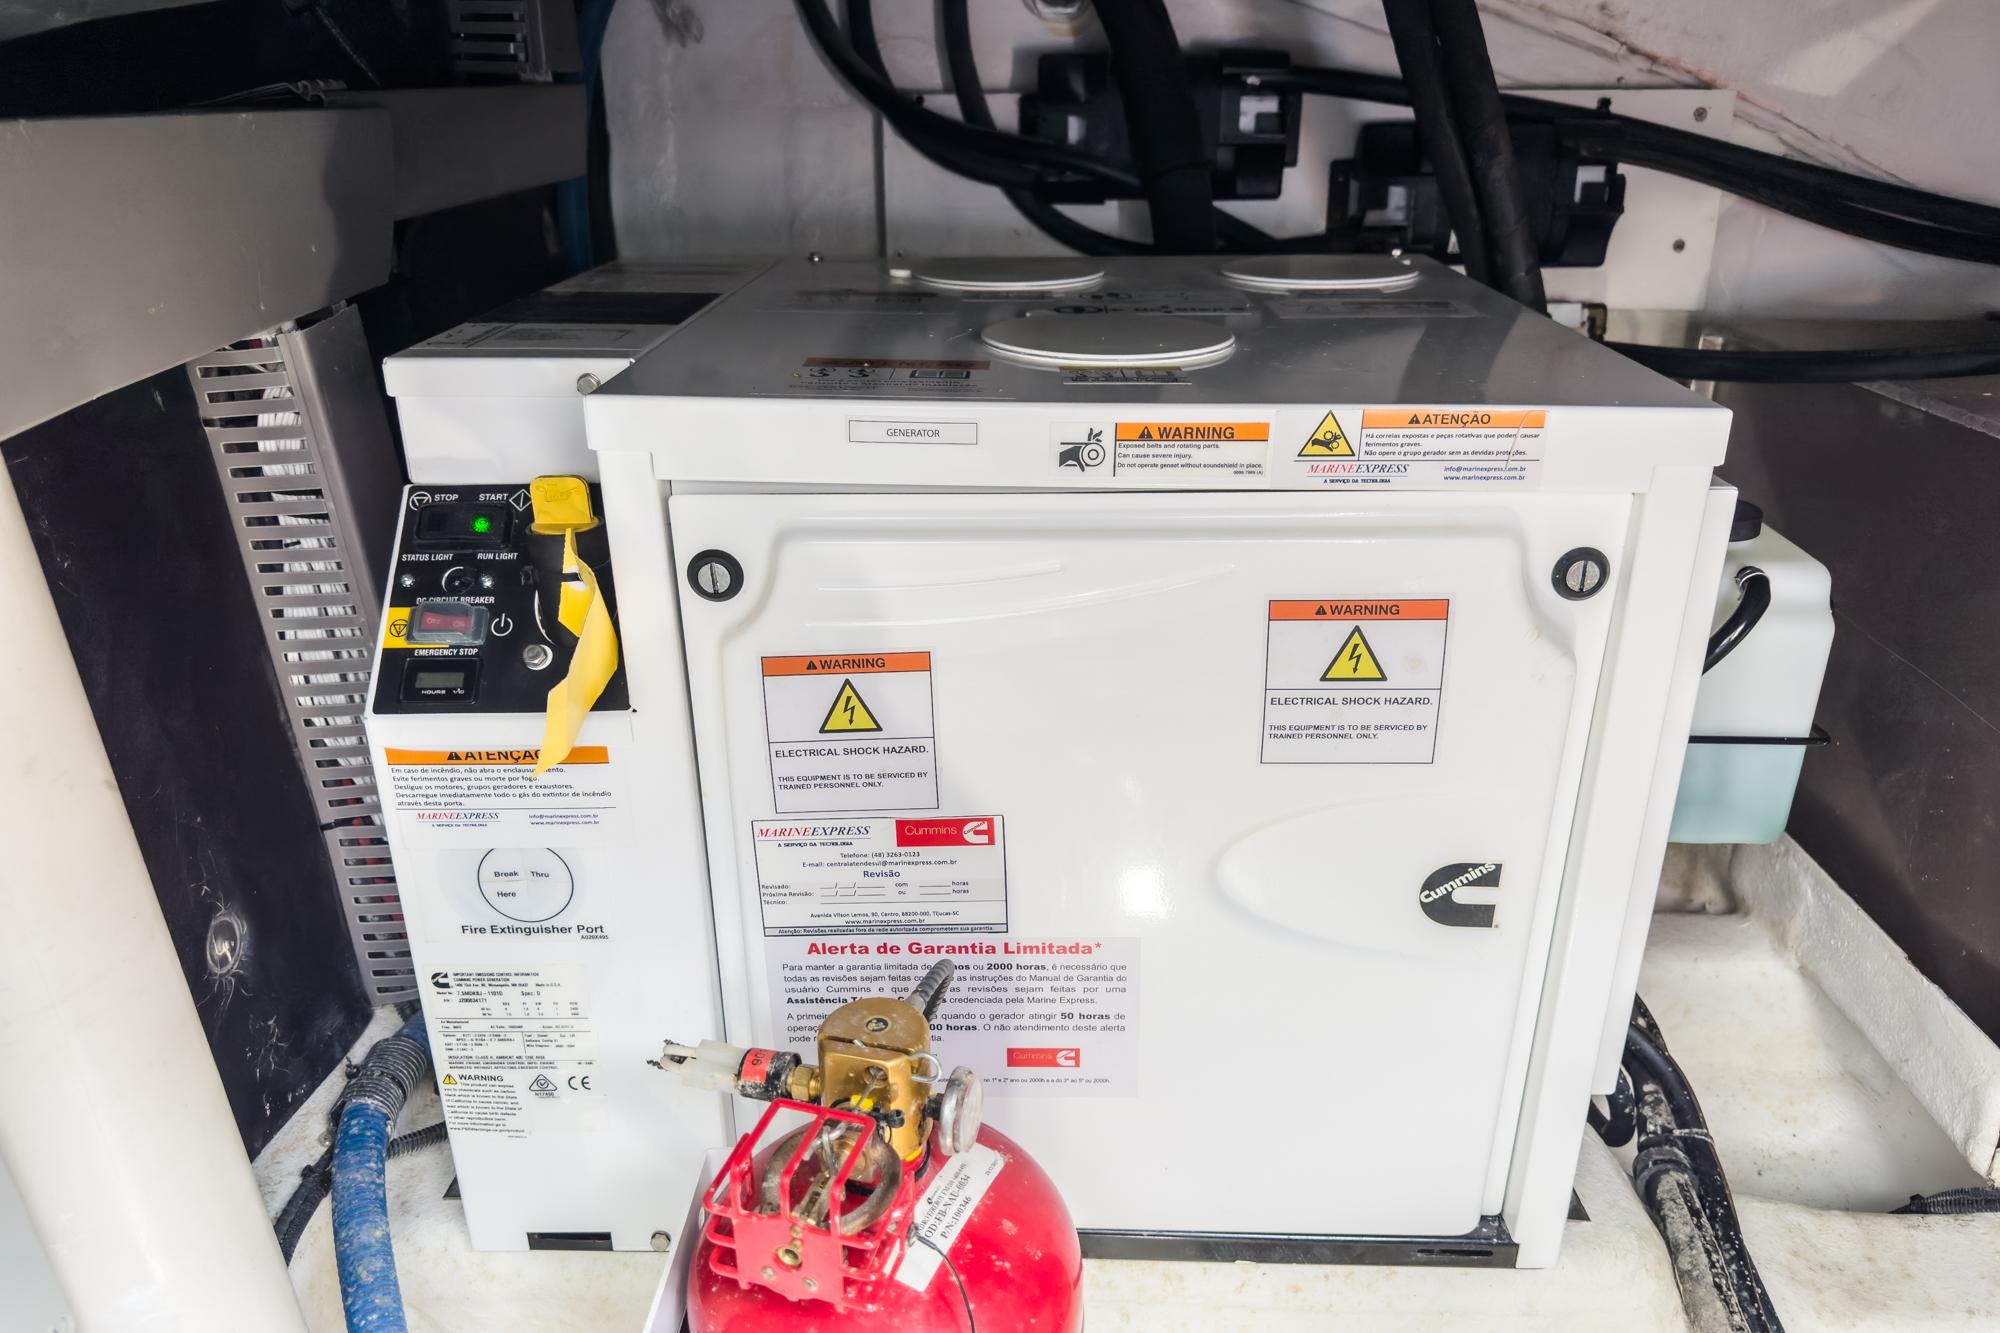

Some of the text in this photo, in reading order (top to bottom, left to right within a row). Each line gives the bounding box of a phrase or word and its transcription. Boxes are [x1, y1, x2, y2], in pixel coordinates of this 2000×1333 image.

[1422, 413, 1492, 428] ATENÇÃO
[886, 428, 940, 437] GENERATOR
[1157, 426, 1235, 440] WARNING
[1307, 464, 1410, 473] MARINEEXPRESS
[478, 493, 510, 501] START
[401, 553, 429, 561] STATUS
[1330, 604, 1400, 615] WARNING
[414, 648, 458, 656] EMERGENCY
[819, 657, 886, 670] WARNING
[1270, 697, 1432, 705] ELECTRICAL SHOCK HAZARD.
[775, 745, 928, 758] ELECTRICAL SHOCK HAZARD.
[813, 781, 860, 789] PERSONNEL
[757, 825, 870, 837] MARINEEXPRESS
[904, 825, 957, 835] Cummins
[863, 869, 900, 877] Revisão
[1419, 862, 1496, 903] Cummins
[461, 924, 604, 936] Fire Extinguisher Port
[807, 942, 869, 954] Alerta
[876, 942, 901, 954] de
[907, 942, 996, 954] Garantia
[782, 963, 802, 971] Para
[846, 963, 881, 972] garantia
[920, 963, 932, 972] de
[860, 975, 885, 983] sejam
[969, 974, 1013, 982] instruções
[826, 985, 871, 993] Cummins
[891, 986, 909, 994] que
[786, 996, 849, 1005] Assistência
[1005, 996, 1024, 1005] pela
[1059, 996, 1097, 1004] Express.
[941, 1012, 976, 1020] quando
[988, 1012, 1025, 1021] gerador
[1028, 1013, 1057, 1021] atingir
[945, 1023, 977, 1031] horas.
[788, 1035, 811, 1043] pode
